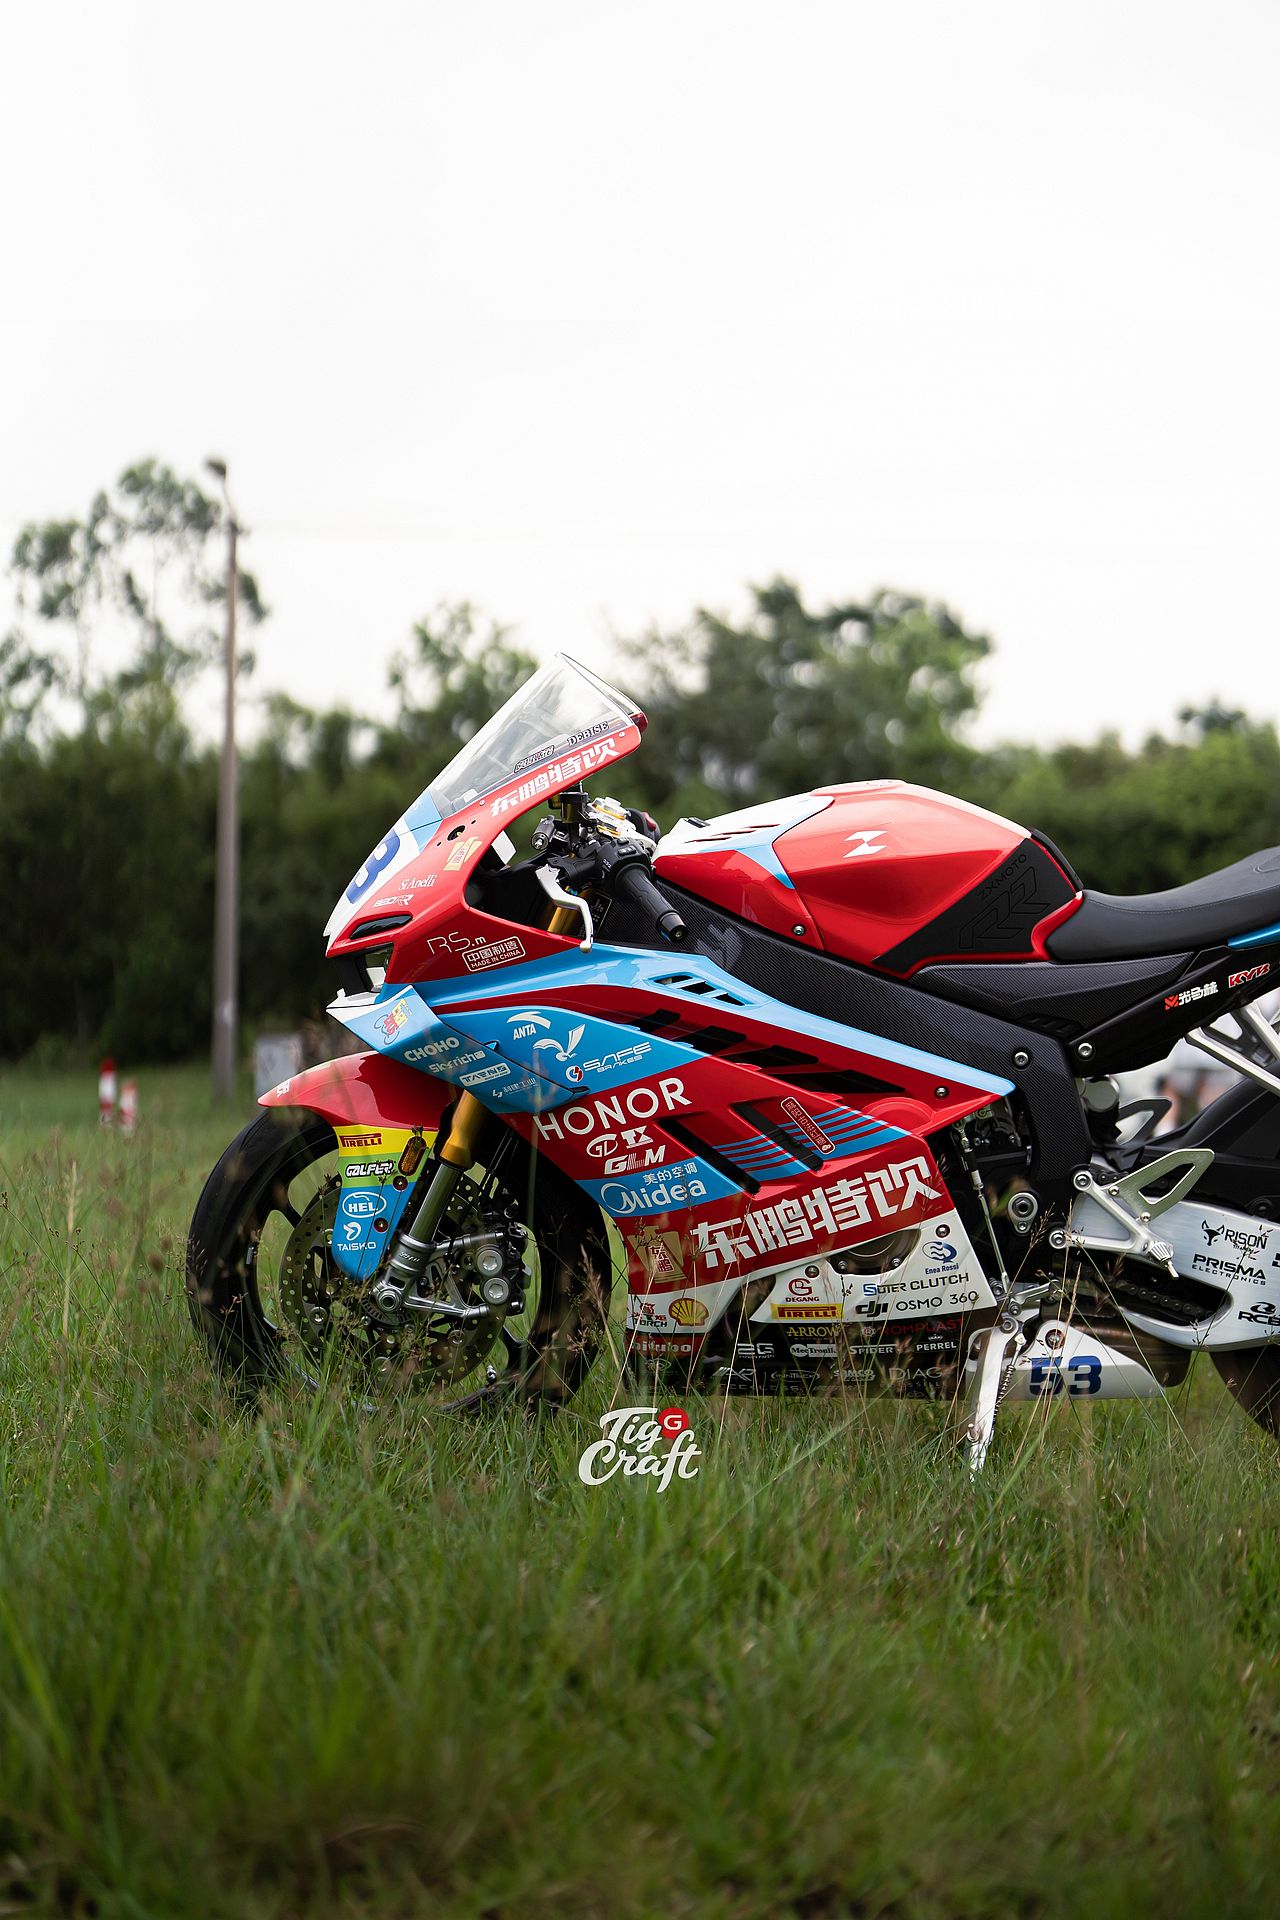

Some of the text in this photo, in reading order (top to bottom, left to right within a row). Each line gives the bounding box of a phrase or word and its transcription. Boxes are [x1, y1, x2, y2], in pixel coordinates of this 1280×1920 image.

[567, 721, 609, 746] DEBISE
[977, 854, 1027, 901] ZXMOTO
[467, 940, 519, 962] 中国制造
[470, 949, 521, 969] MADE IN CHINA
[1228, 963, 1271, 988] KYB
[513, 1023, 537, 1041] ANTA
[403, 1036, 460, 1063] CHOHO
[583, 1041, 652, 1072] SAFE
[533, 1077, 692, 1141] HONOR
[339, 1132, 382, 1148] PIRELLI
[643, 1161, 698, 1186] 美的空调
[348, 1202, 378, 1213] HEL
[600, 1179, 707, 1214] Midea
[689, 1156, 942, 1268] 东鹏特饮
[1224, 1228, 1268, 1250] RISON
[925, 1262, 959, 1275] Enea Rossi
[1191, 1264, 1266, 1286] ELECTRONICS
[1193, 1253, 1266, 1280] PRISMA
[910, 1273, 969, 1290] CLUTCH
[785, 1295, 820, 1303] DEGANG
[896, 1296, 943, 1312] OSMO
[949, 1290, 979, 1305] 360
[777, 1305, 838, 1319] PIRELLI
[849, 1343, 896, 1355] SPIDER
[916, 1341, 958, 1352] PERREL
[1029, 1354, 1103, 1397] 53
